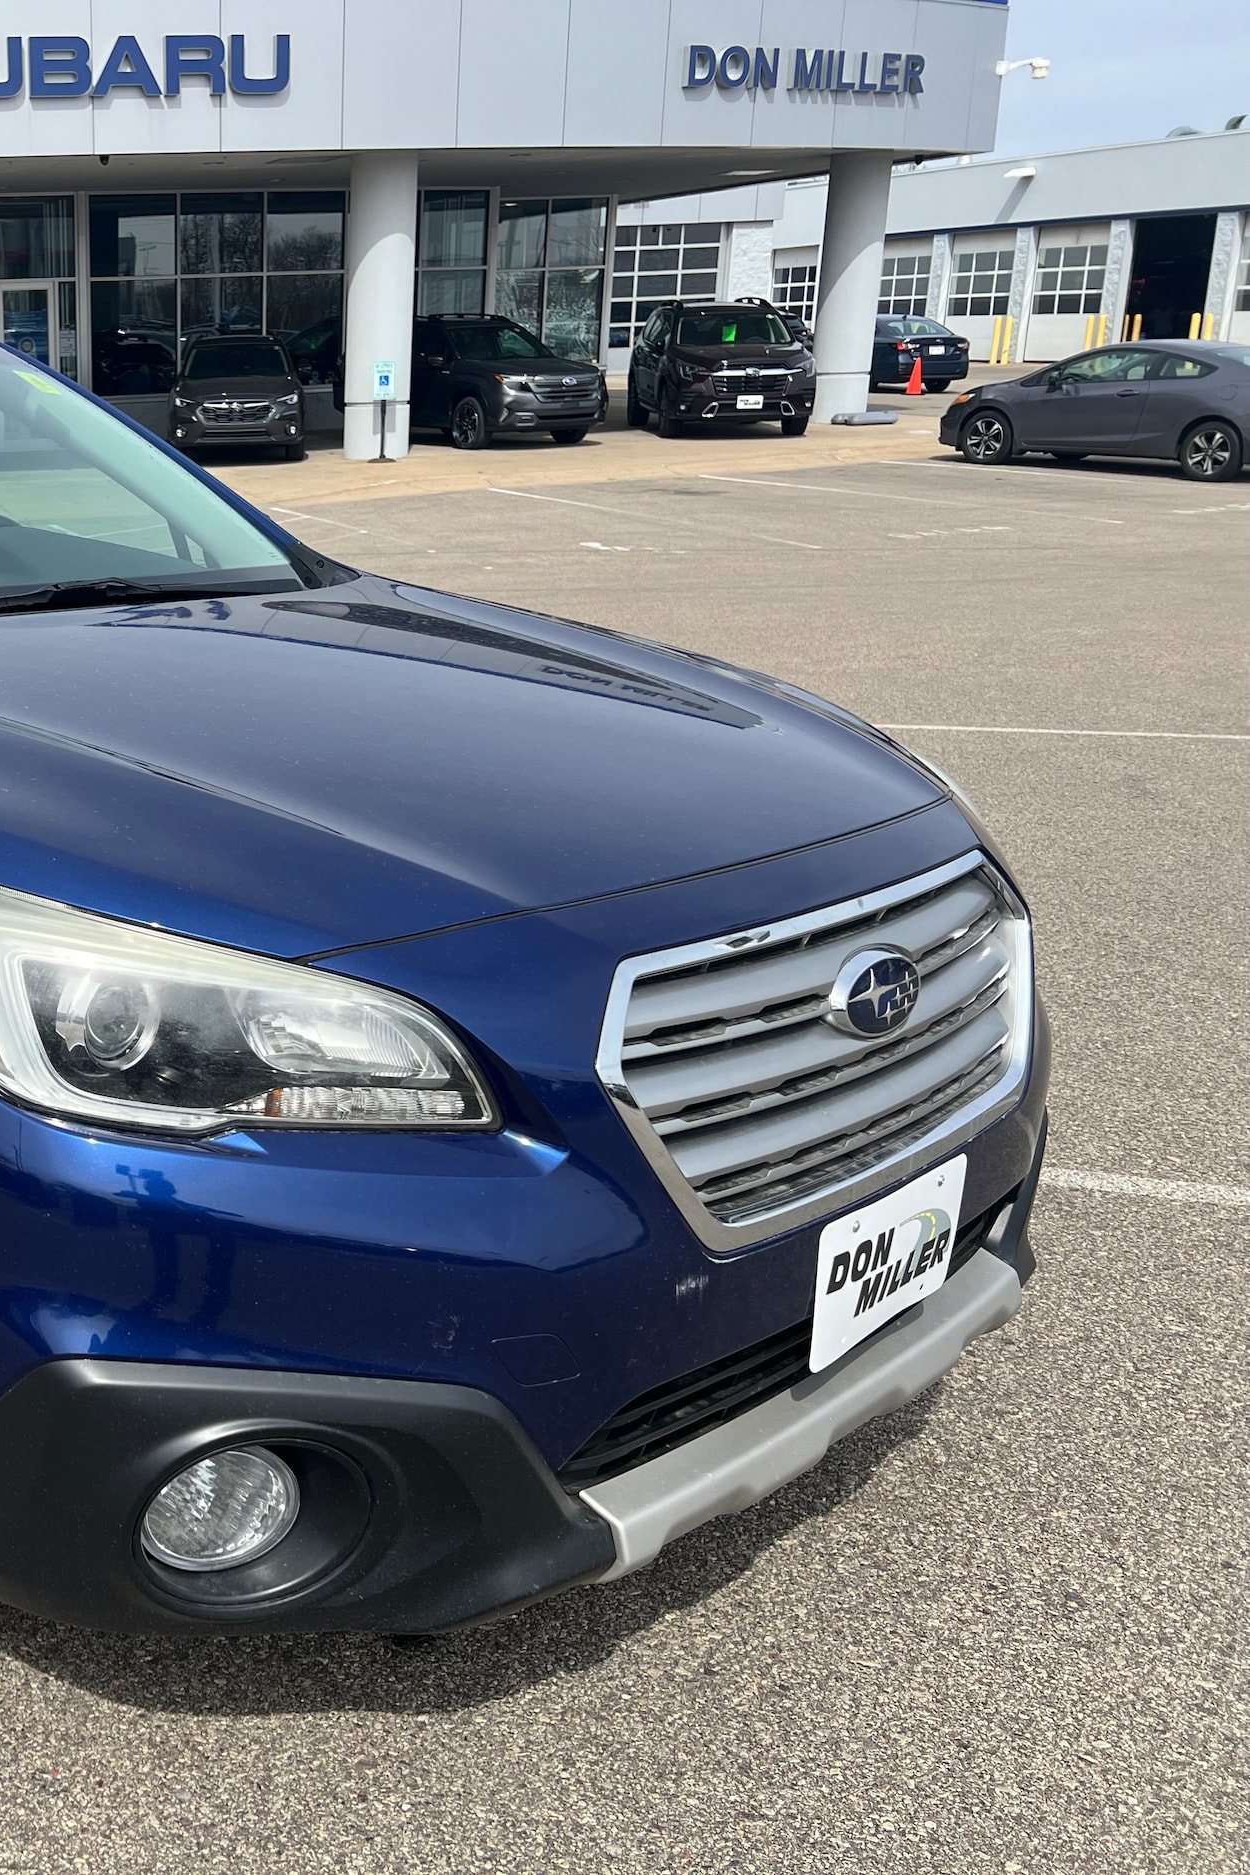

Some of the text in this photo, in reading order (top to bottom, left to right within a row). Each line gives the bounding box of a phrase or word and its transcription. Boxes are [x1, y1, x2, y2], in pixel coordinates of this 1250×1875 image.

[684, 44, 926, 94] DON MILLER
[826, 1226, 896, 1295] DON
[853, 1228, 951, 1318] MILLER
